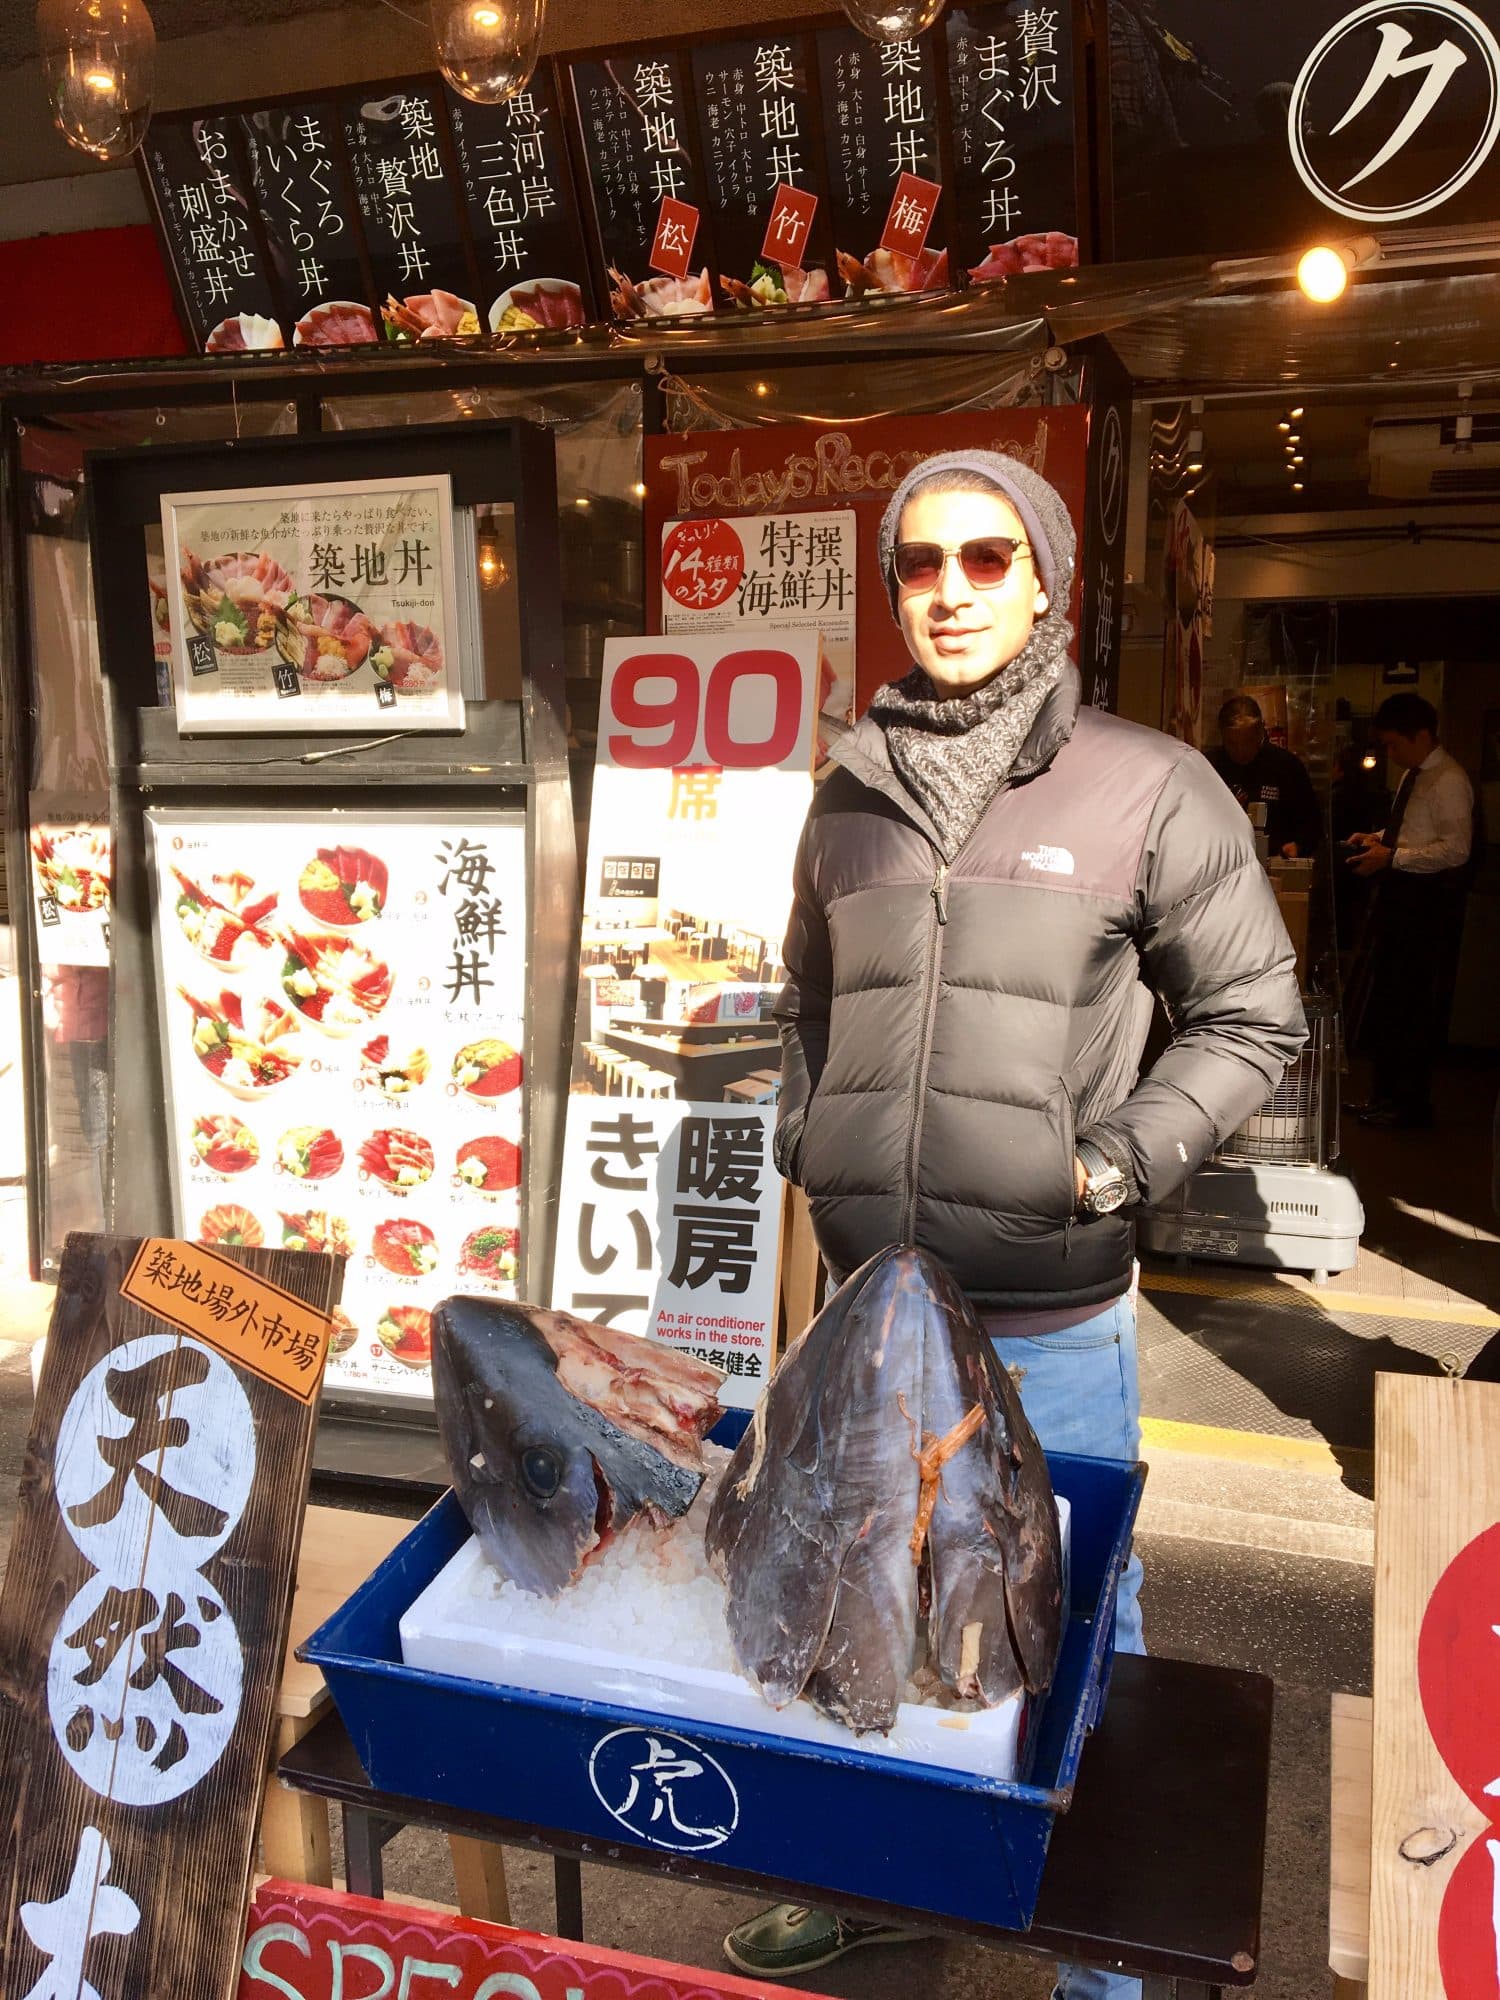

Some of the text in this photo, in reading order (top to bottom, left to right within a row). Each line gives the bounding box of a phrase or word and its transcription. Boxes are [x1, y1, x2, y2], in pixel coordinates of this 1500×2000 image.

[880, 39, 928, 176] 築地丼
[956, 37, 972, 165] 赤身 中トロ 大トロ
[1015, 7, 1062, 111] 贅沢
[351, 154, 363, 185] イクラ
[399, 97, 444, 180] 築地
[460, 139, 470, 173] イクラ
[502, 88, 556, 219] 魚河岸
[589, 88, 600, 111] ウニ
[600, 149, 616, 221] カニフレーク
[601, 87, 626, 196] ホタテ 穴子 イクラ
[621, 128, 633, 163] 中トロ
[634, 61, 685, 203] 築地丼
[705, 72, 728, 209] ウニ 海老 カニフレーク
[719, 71, 741, 196] サーモン 穴子 イクラ
[733, 68, 757, 216] 赤身 中トロ 大トロ 白身
[754, 44, 804, 191] 築地丼
[834, 55, 855, 208] イクラ 海老 カニフレーク
[849, 52, 871, 215] 赤身 大トロ 白身 サーモン
[974, 35, 1022, 234] まぐろ丼
[198, 129, 255, 278] おまかせ
[266, 144, 329, 297] いくら丼
[295, 116, 344, 235] まぐろ
[362, 152, 374, 185] 大トロ
[370, 192, 383, 225] 中トロ
[376, 157, 431, 282] 贅沢丼
[476, 141, 528, 272] 三色丼
[628, 171, 640, 194] 白身
[633, 200, 648, 247] サーモン
[774, 205, 805, 245] 竹
[892, 195, 928, 235] 梅
[177, 182, 234, 305] 刺盛丼
[658, 218, 690, 256] 松
[308, 539, 433, 589] 築地丼
[676, 577, 728, 606] のネタ
[736, 567, 854, 616] 海鮮丼
[760, 520, 842, 568] 特撰
[192, 641, 211, 664] 松
[391, 599, 434, 608] Tsukiji-don
[278, 669, 293, 689] 竹
[608, 650, 803, 770] 90
[666, 763, 723, 820] 席
[434, 837, 507, 1006] 海鮮丼
[667, 1115, 766, 1294] 暖房
[142, 1246, 320, 1372] 築地場外市場
[657, 1310, 765, 1331] An air conditioner
[657, 1327, 765, 1347] works in the store.
